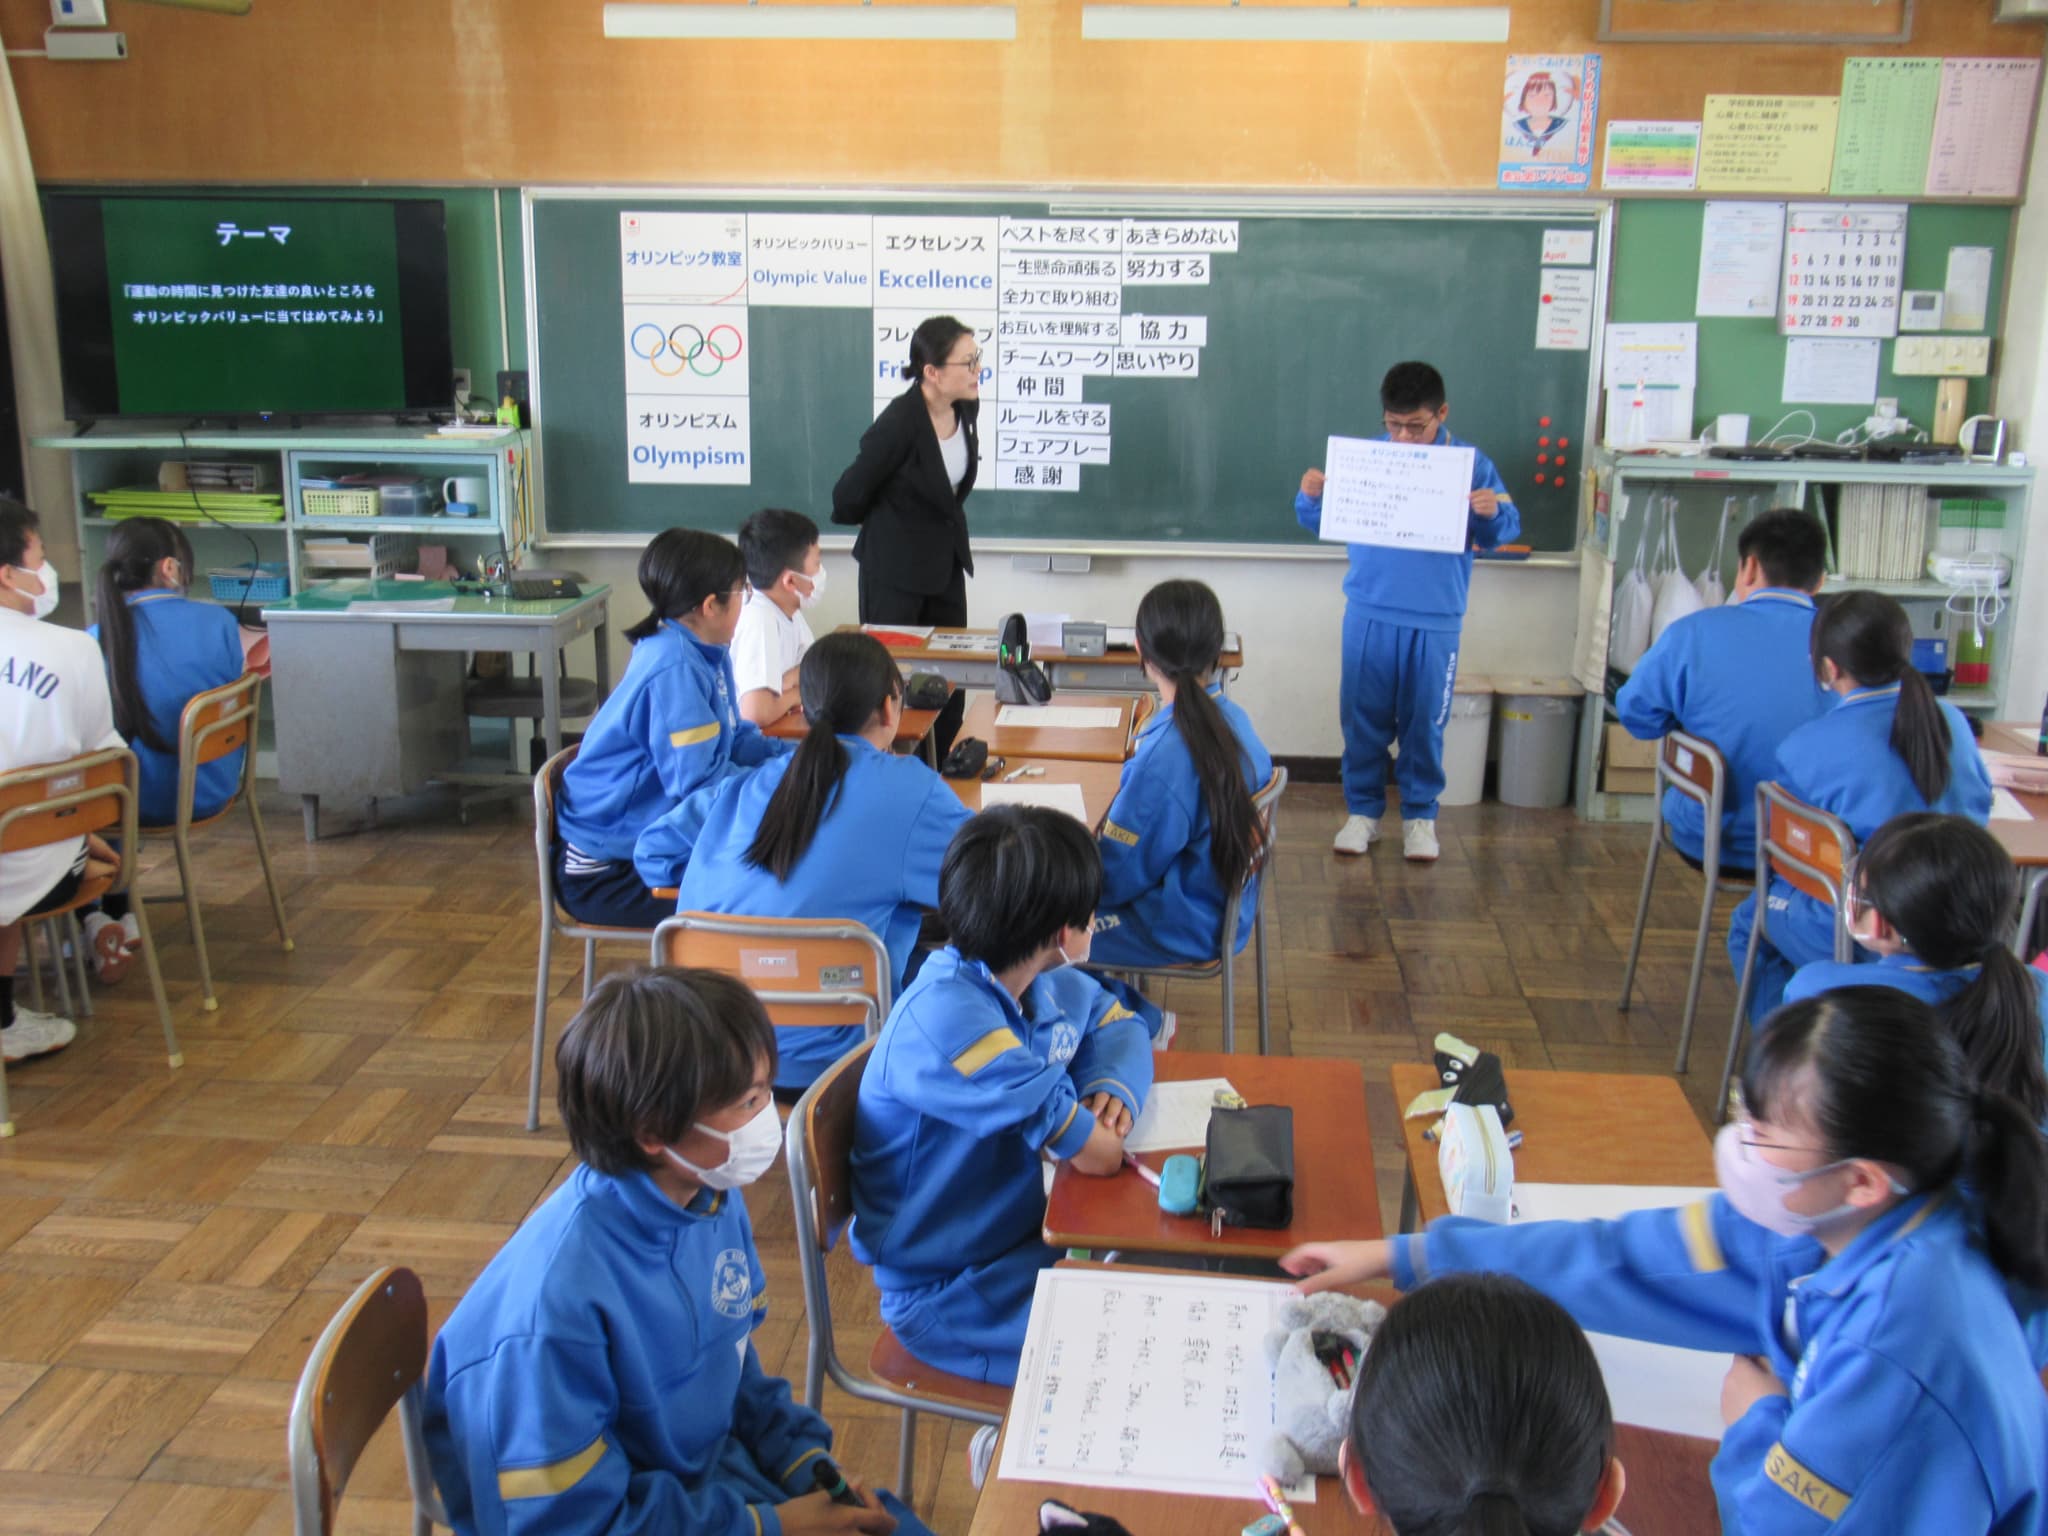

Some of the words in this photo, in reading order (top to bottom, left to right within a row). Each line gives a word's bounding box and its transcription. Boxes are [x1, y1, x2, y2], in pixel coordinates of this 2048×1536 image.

[1841, 215, 1850, 229] 4
[216, 222, 291, 246] テーマ
[886, 234, 985, 251] エクセレンス
[1002, 228, 1119, 243] ベストを尽くす
[1126, 229, 1236, 245] あきらめない
[1842, 233, 1847, 246] 1
[1857, 234, 1864, 246] 2
[1874, 234, 1881, 247] 3
[1890, 233, 1897, 246] 4
[752, 237, 868, 251] オリンピックバリュー
[626, 250, 742, 267] オリンピック教室
[1544, 251, 1567, 262] April
[1792, 254, 1799, 266] 5
[1808, 254, 1814, 266] 6
[1824, 254, 1830, 266] 7
[1839, 254, 1846, 266] 8
[1856, 254, 1862, 266] 9
[1870, 255, 1881, 267] 10
[1888, 255, 1897, 267] 11
[1001, 259, 1117, 277] 一生懸命頑張る
[1127, 260, 1205, 278] 努力する
[753, 269, 818, 287] Olympic
[824, 270, 868, 285] Value
[879, 269, 993, 289] Excellence
[1789, 274, 1799, 286] 12
[1804, 274, 1814, 286] 13
[1820, 275, 1830, 287] 14
[1835, 275, 1846, 287] 15
[1851, 275, 1862, 287] 16
[1868, 275, 1880, 287] 17
[1884, 276, 1896, 288] 18
[1002, 289, 1118, 306] 全力で取り組む
[1788, 294, 1798, 306] 19
[1802, 294, 1814, 307] 20
[1817, 295, 1828, 307] 21
[1832, 295, 1845, 308] 22
[1848, 295, 1861, 308] 23
[1865, 296, 1878, 308] 24
[1881, 296, 1895, 308] 25
[1000, 321, 1118, 337] お互いを理解する
[1140, 320, 1188, 340] 協力
[1800, 315, 1812, 327] 27
[1816, 315, 1828, 327] 28
[1831, 315, 1844, 327] 29
[1847, 316, 1860, 328] 30
[1002, 350, 1109, 368] チームワーク
[1117, 352, 1194, 371] 思いやり
[1017, 376, 1064, 397] 仲間
[640, 413, 737, 430] オリンピズム
[1000, 408, 1106, 427] ルールを守る
[1003, 437, 1108, 456] フェアプレー
[633, 445, 745, 469] Olympism
[1014, 465, 1062, 485] 感謝
[1769, 1455, 1830, 1510] SAKI
